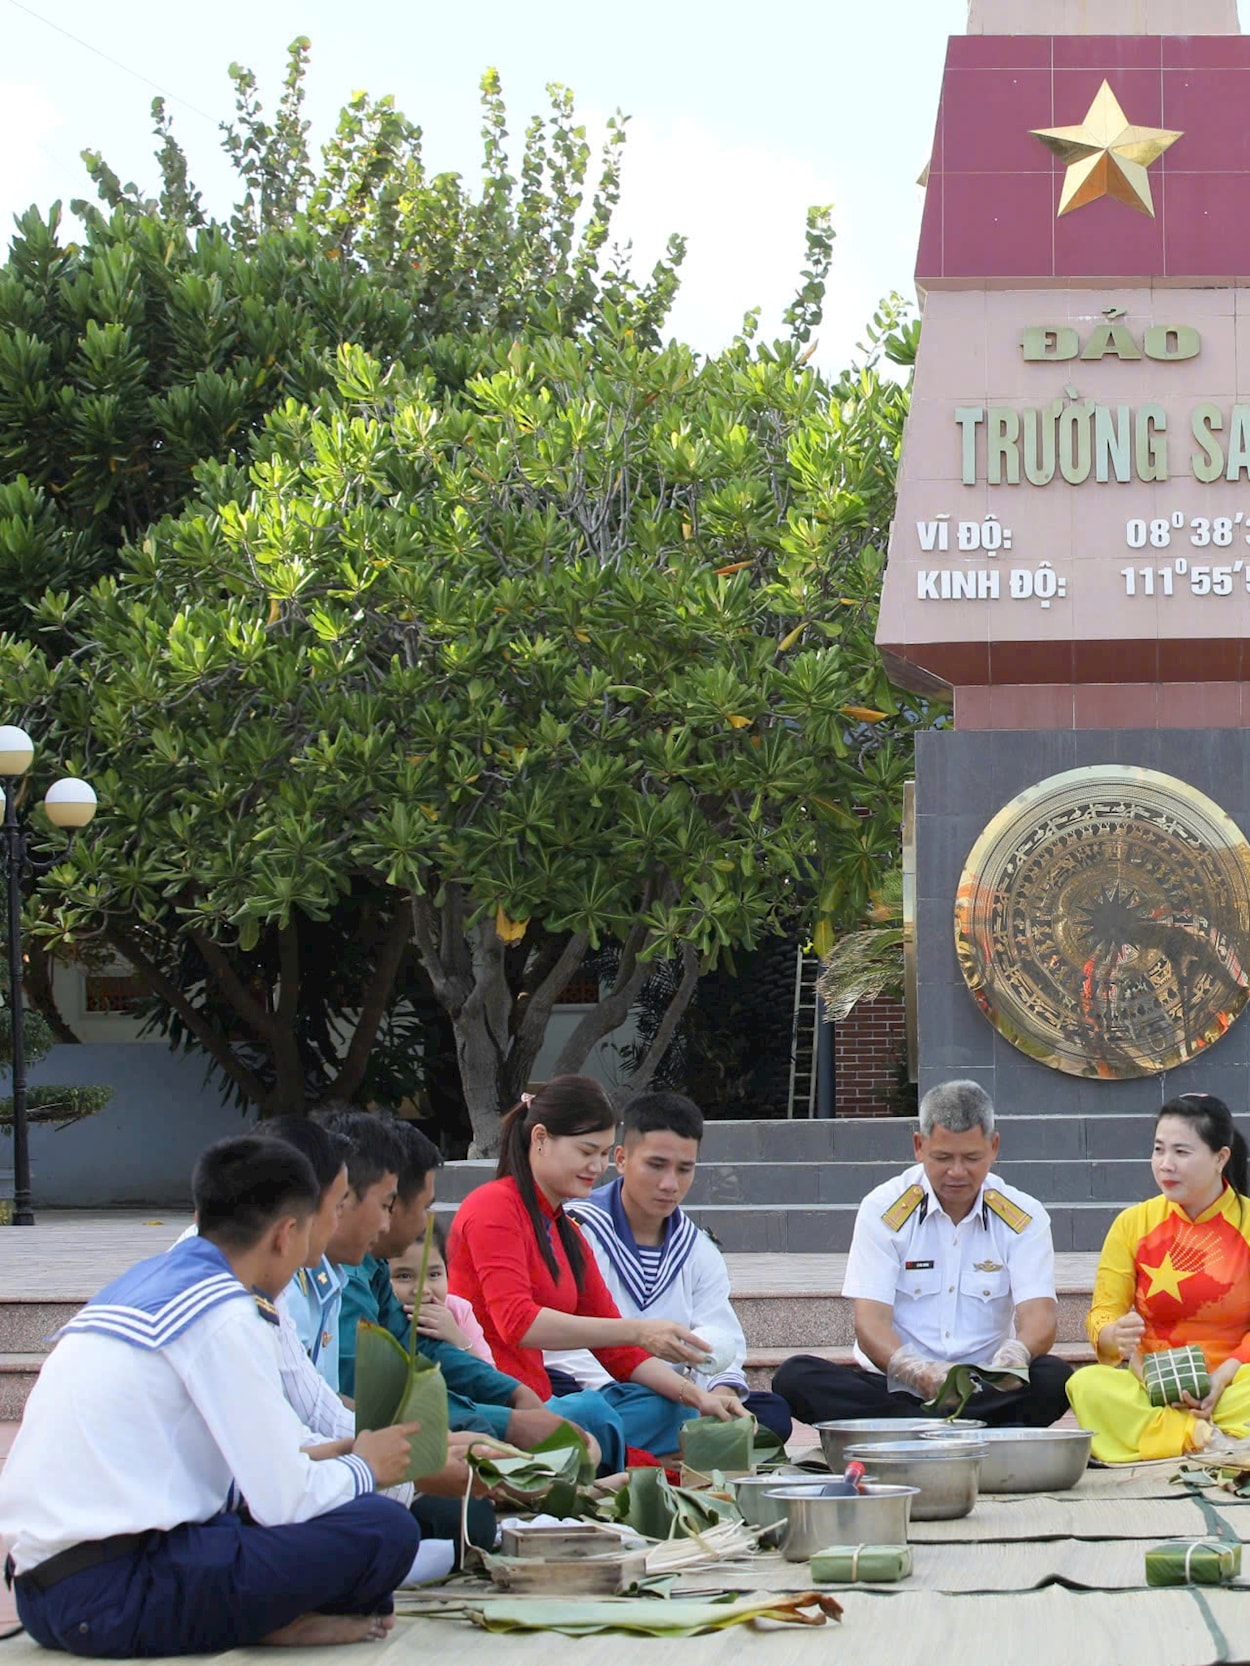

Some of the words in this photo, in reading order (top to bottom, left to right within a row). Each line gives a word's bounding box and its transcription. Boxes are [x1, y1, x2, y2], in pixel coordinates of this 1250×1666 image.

[1020, 306, 1201, 362] ĐẢO
[955, 384, 1168, 487] TRƯỜNG
[916, 514, 949, 551] VĨ
[957, 514, 1012, 558] ĐỘ:
[917, 568, 1000, 600] KINH
[1010, 561, 1067, 609] ĐỘ:
